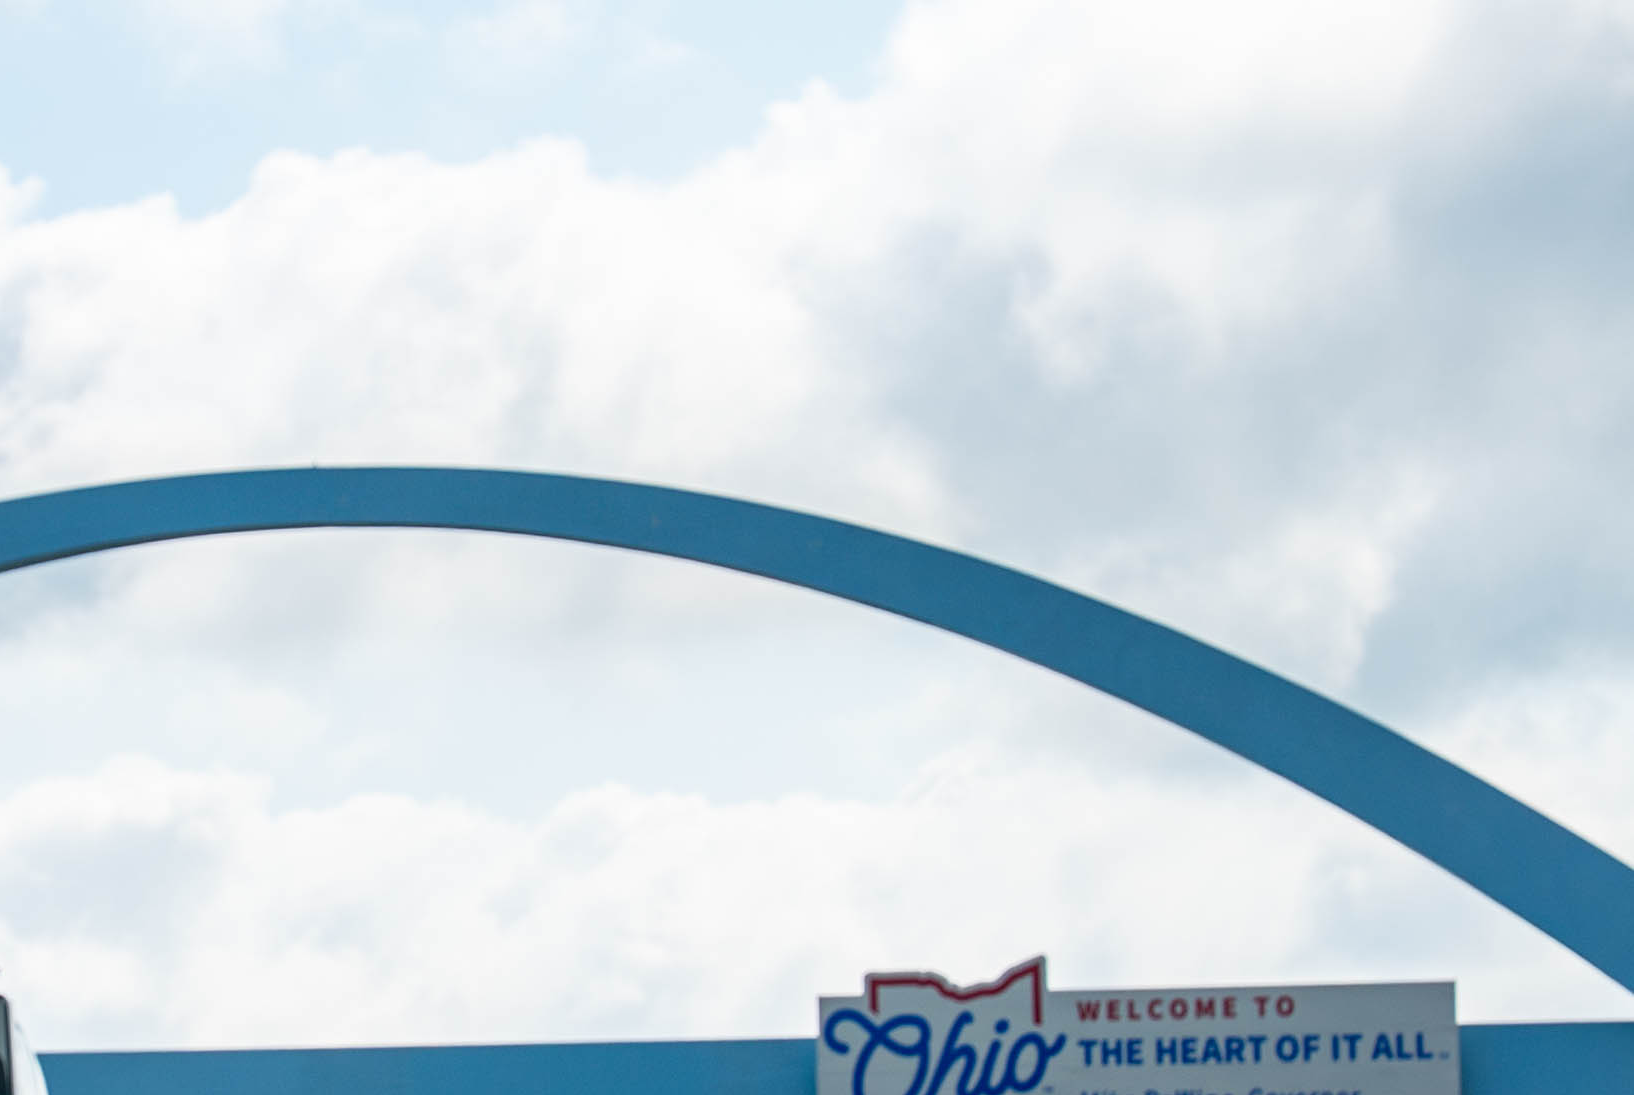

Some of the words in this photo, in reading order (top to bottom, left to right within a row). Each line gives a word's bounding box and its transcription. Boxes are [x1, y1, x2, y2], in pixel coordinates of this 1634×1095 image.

[1077, 996, 1237, 1022] WELCOME
[1253, 995, 1295, 1018] TO
[1078, 1037, 1144, 1067] THE
[1155, 1035, 1268, 1065] HEART
[1276, 1034, 1321, 1064] OF
[1331, 1033, 1363, 1062] IT
